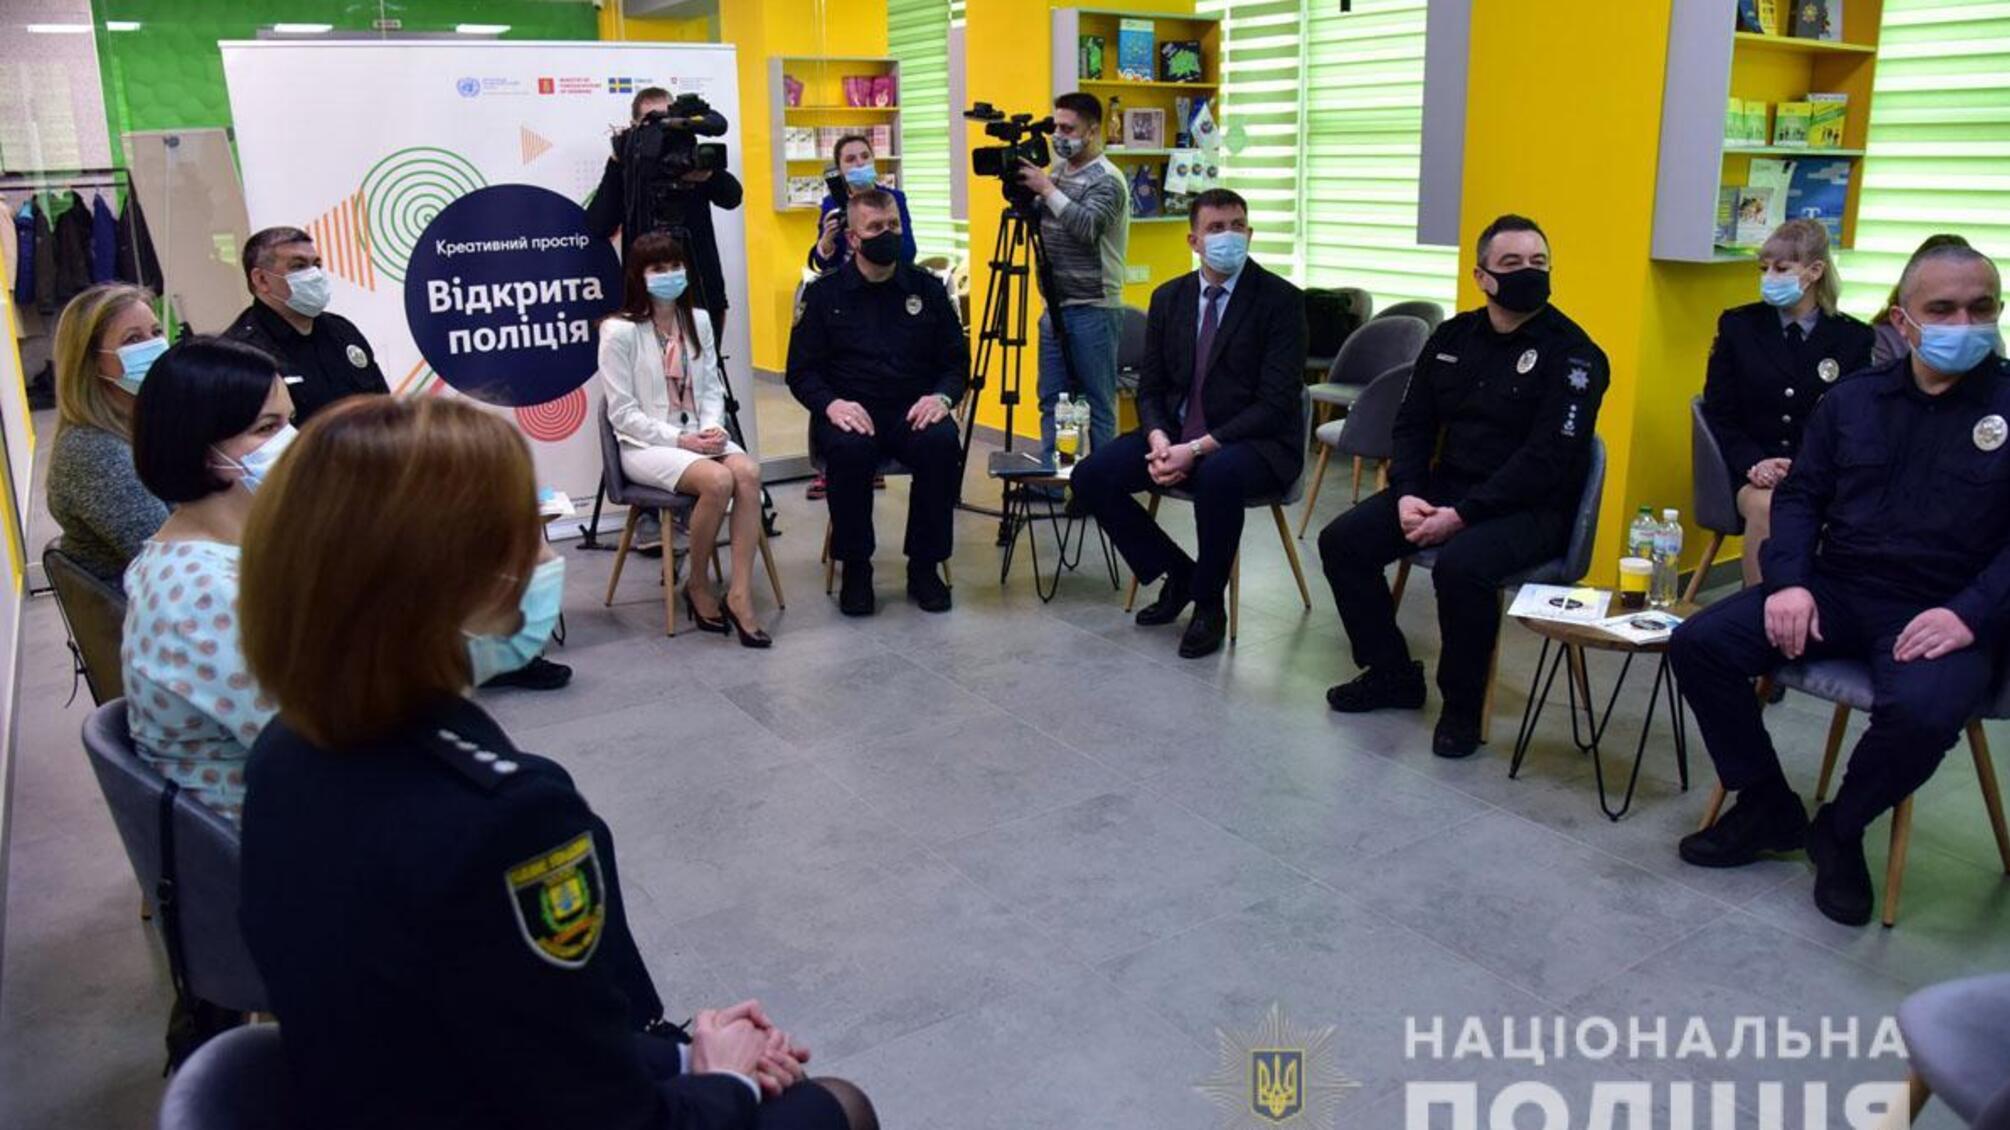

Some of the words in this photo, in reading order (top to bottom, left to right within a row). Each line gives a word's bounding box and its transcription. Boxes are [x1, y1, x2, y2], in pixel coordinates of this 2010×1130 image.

[436, 236, 528, 257] Креативний
[531, 233, 589, 251] простір
[427, 276, 604, 315] Відкрита
[448, 311, 590, 354] поліція
